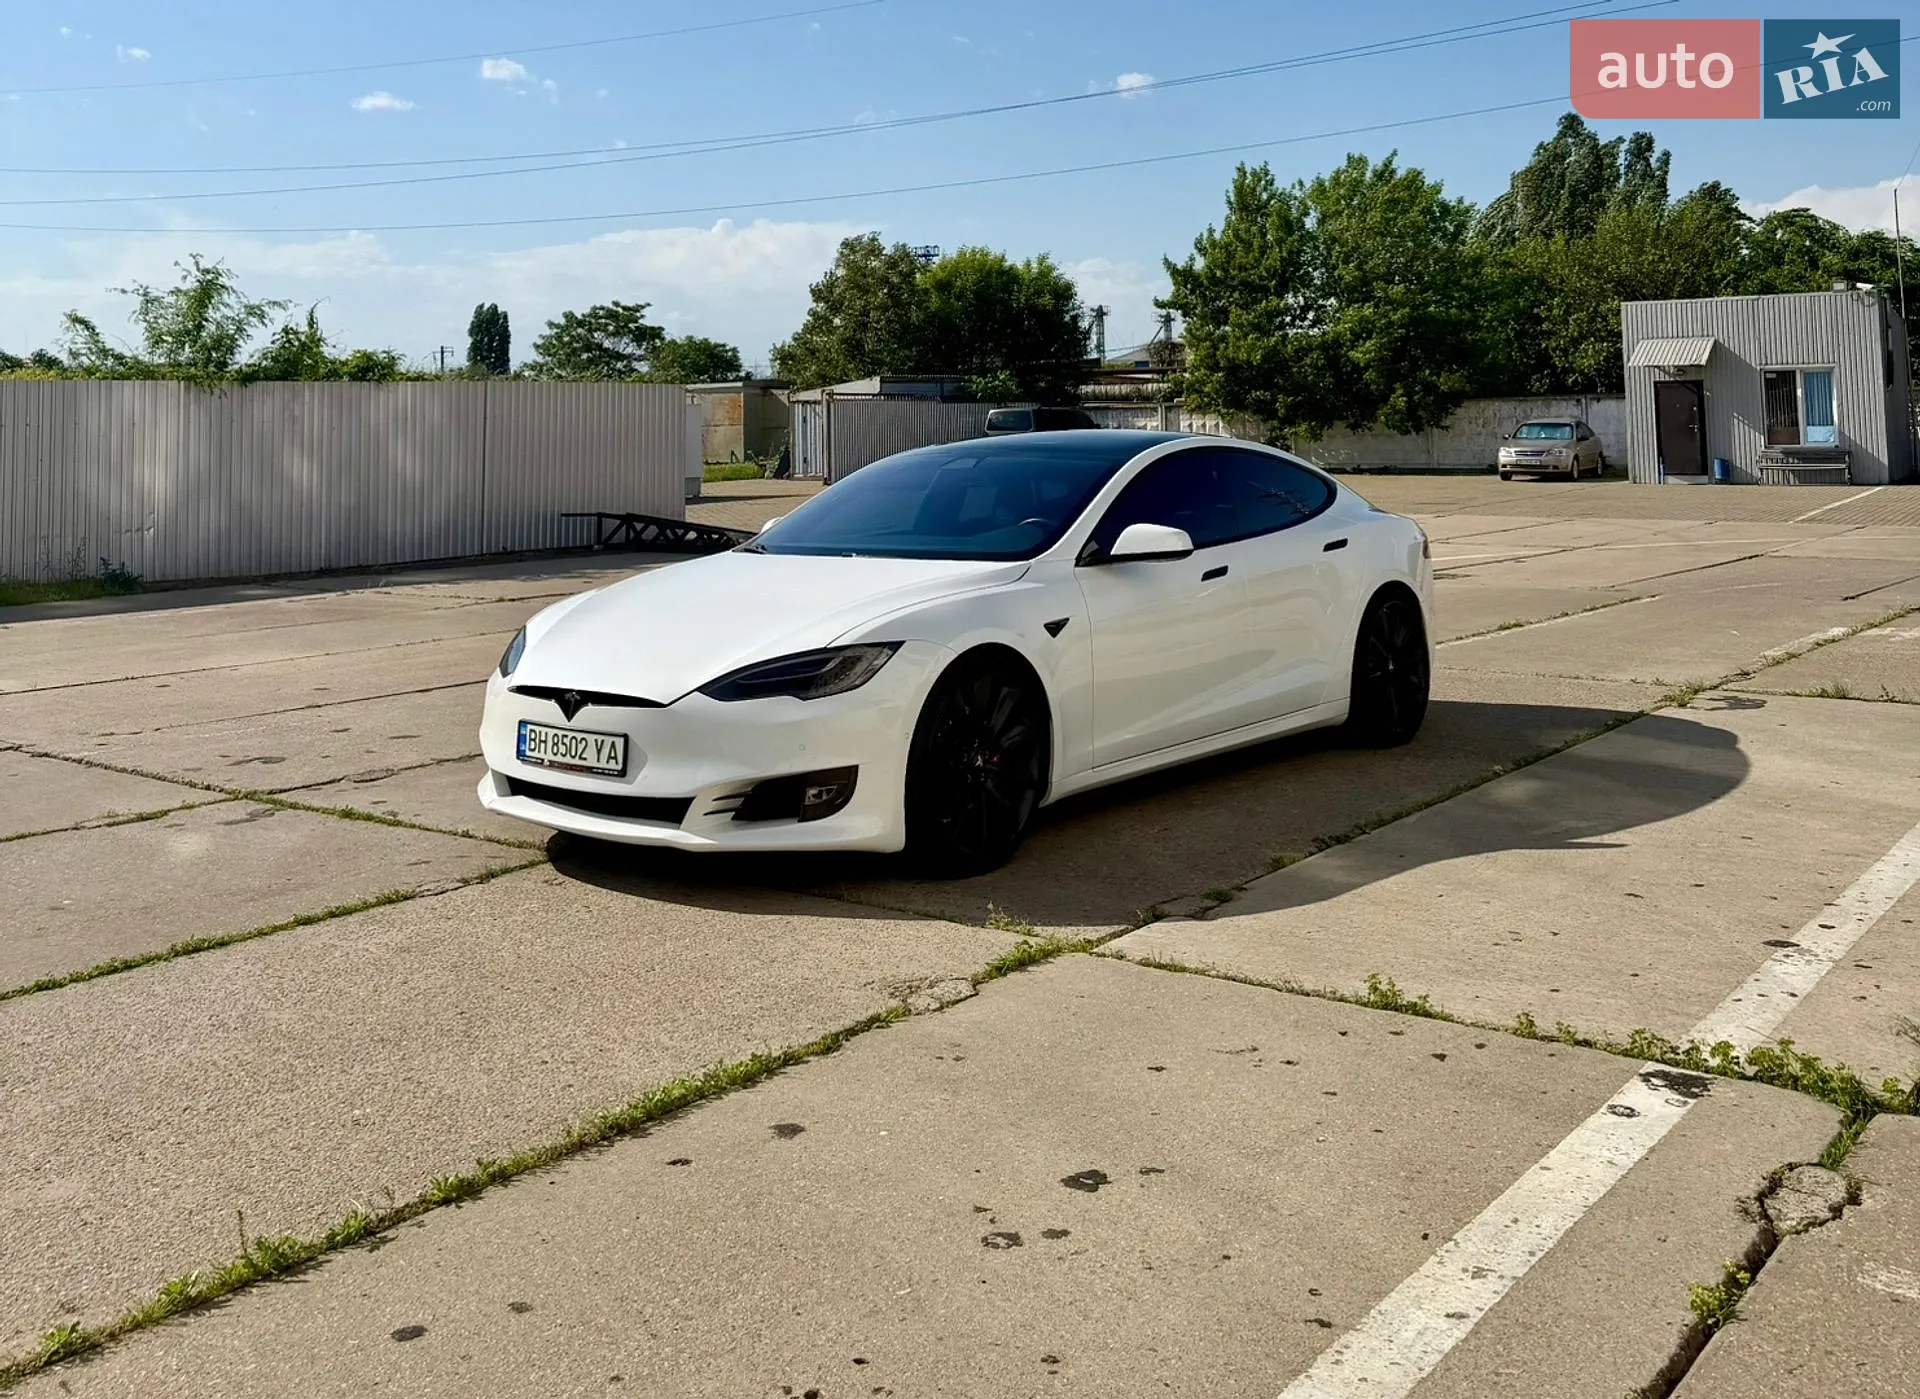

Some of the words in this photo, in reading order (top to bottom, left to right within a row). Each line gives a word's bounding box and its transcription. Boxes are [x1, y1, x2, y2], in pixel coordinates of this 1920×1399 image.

[529, 729, 548, 755] BH
[551, 733, 588, 761] 8502
[594, 738, 619, 765] YA
